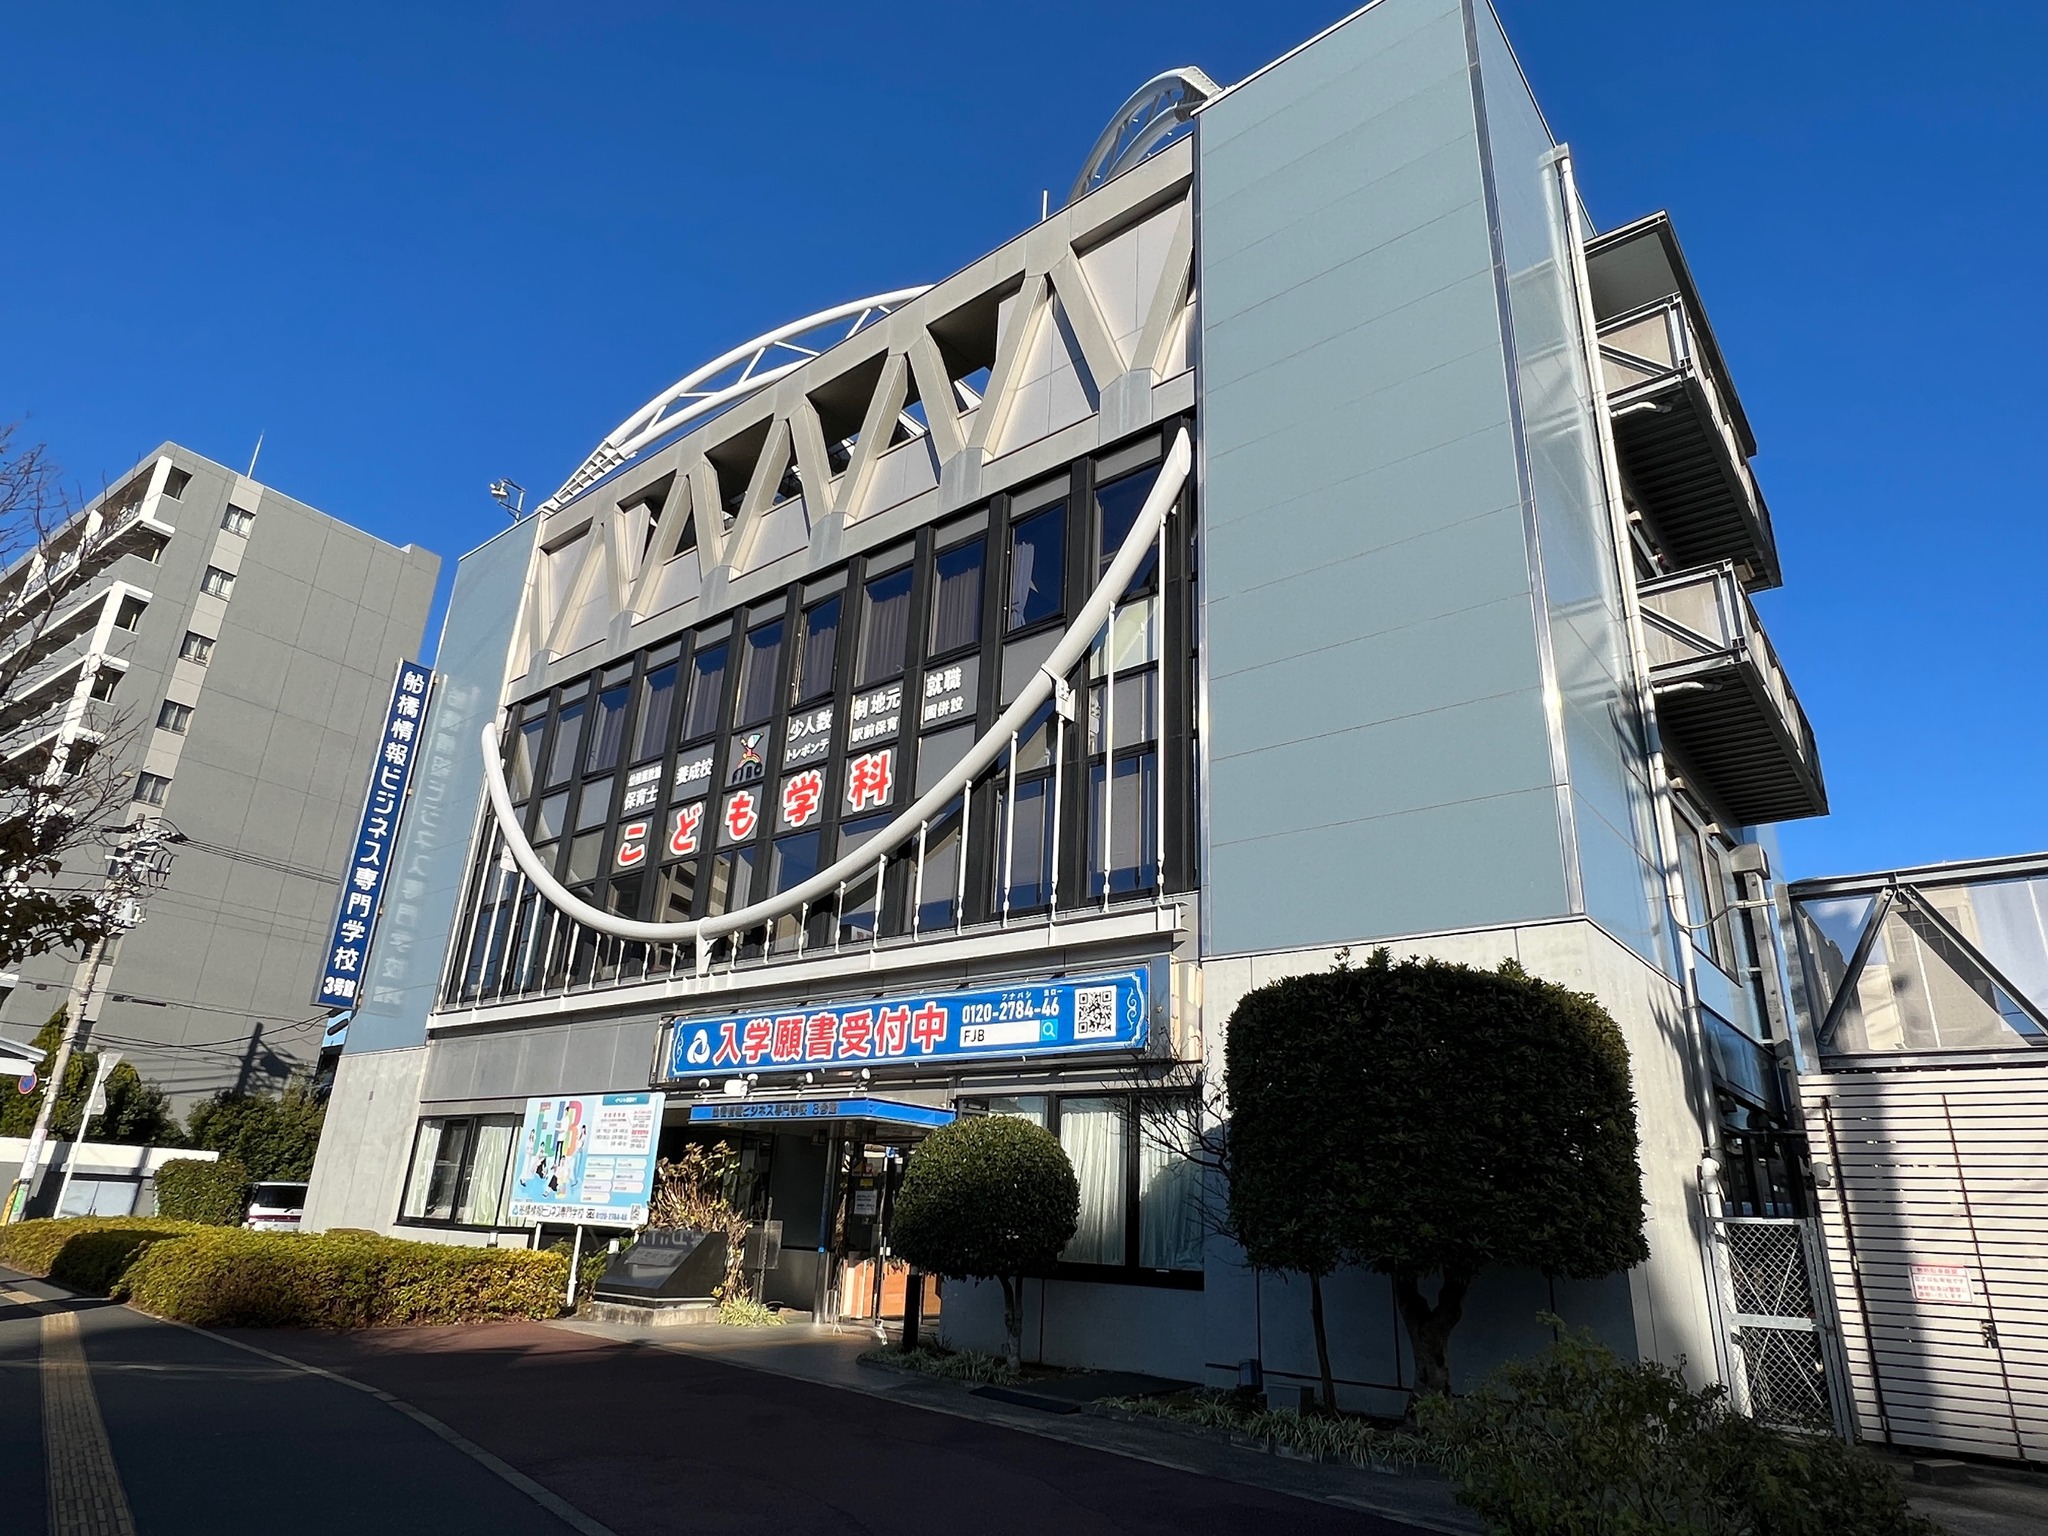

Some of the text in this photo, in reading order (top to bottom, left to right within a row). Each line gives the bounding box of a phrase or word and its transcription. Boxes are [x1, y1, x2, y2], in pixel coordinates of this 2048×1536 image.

[624, 785, 659, 811] 保育士
[333, 670, 425, 972] 船橋情報ビジネス専門学校
[961, 996, 1060, 1024] 0120-2784-46
[713, 1001, 948, 1067] 入学願書受付中
[963, 1028, 985, 1043] FJB
